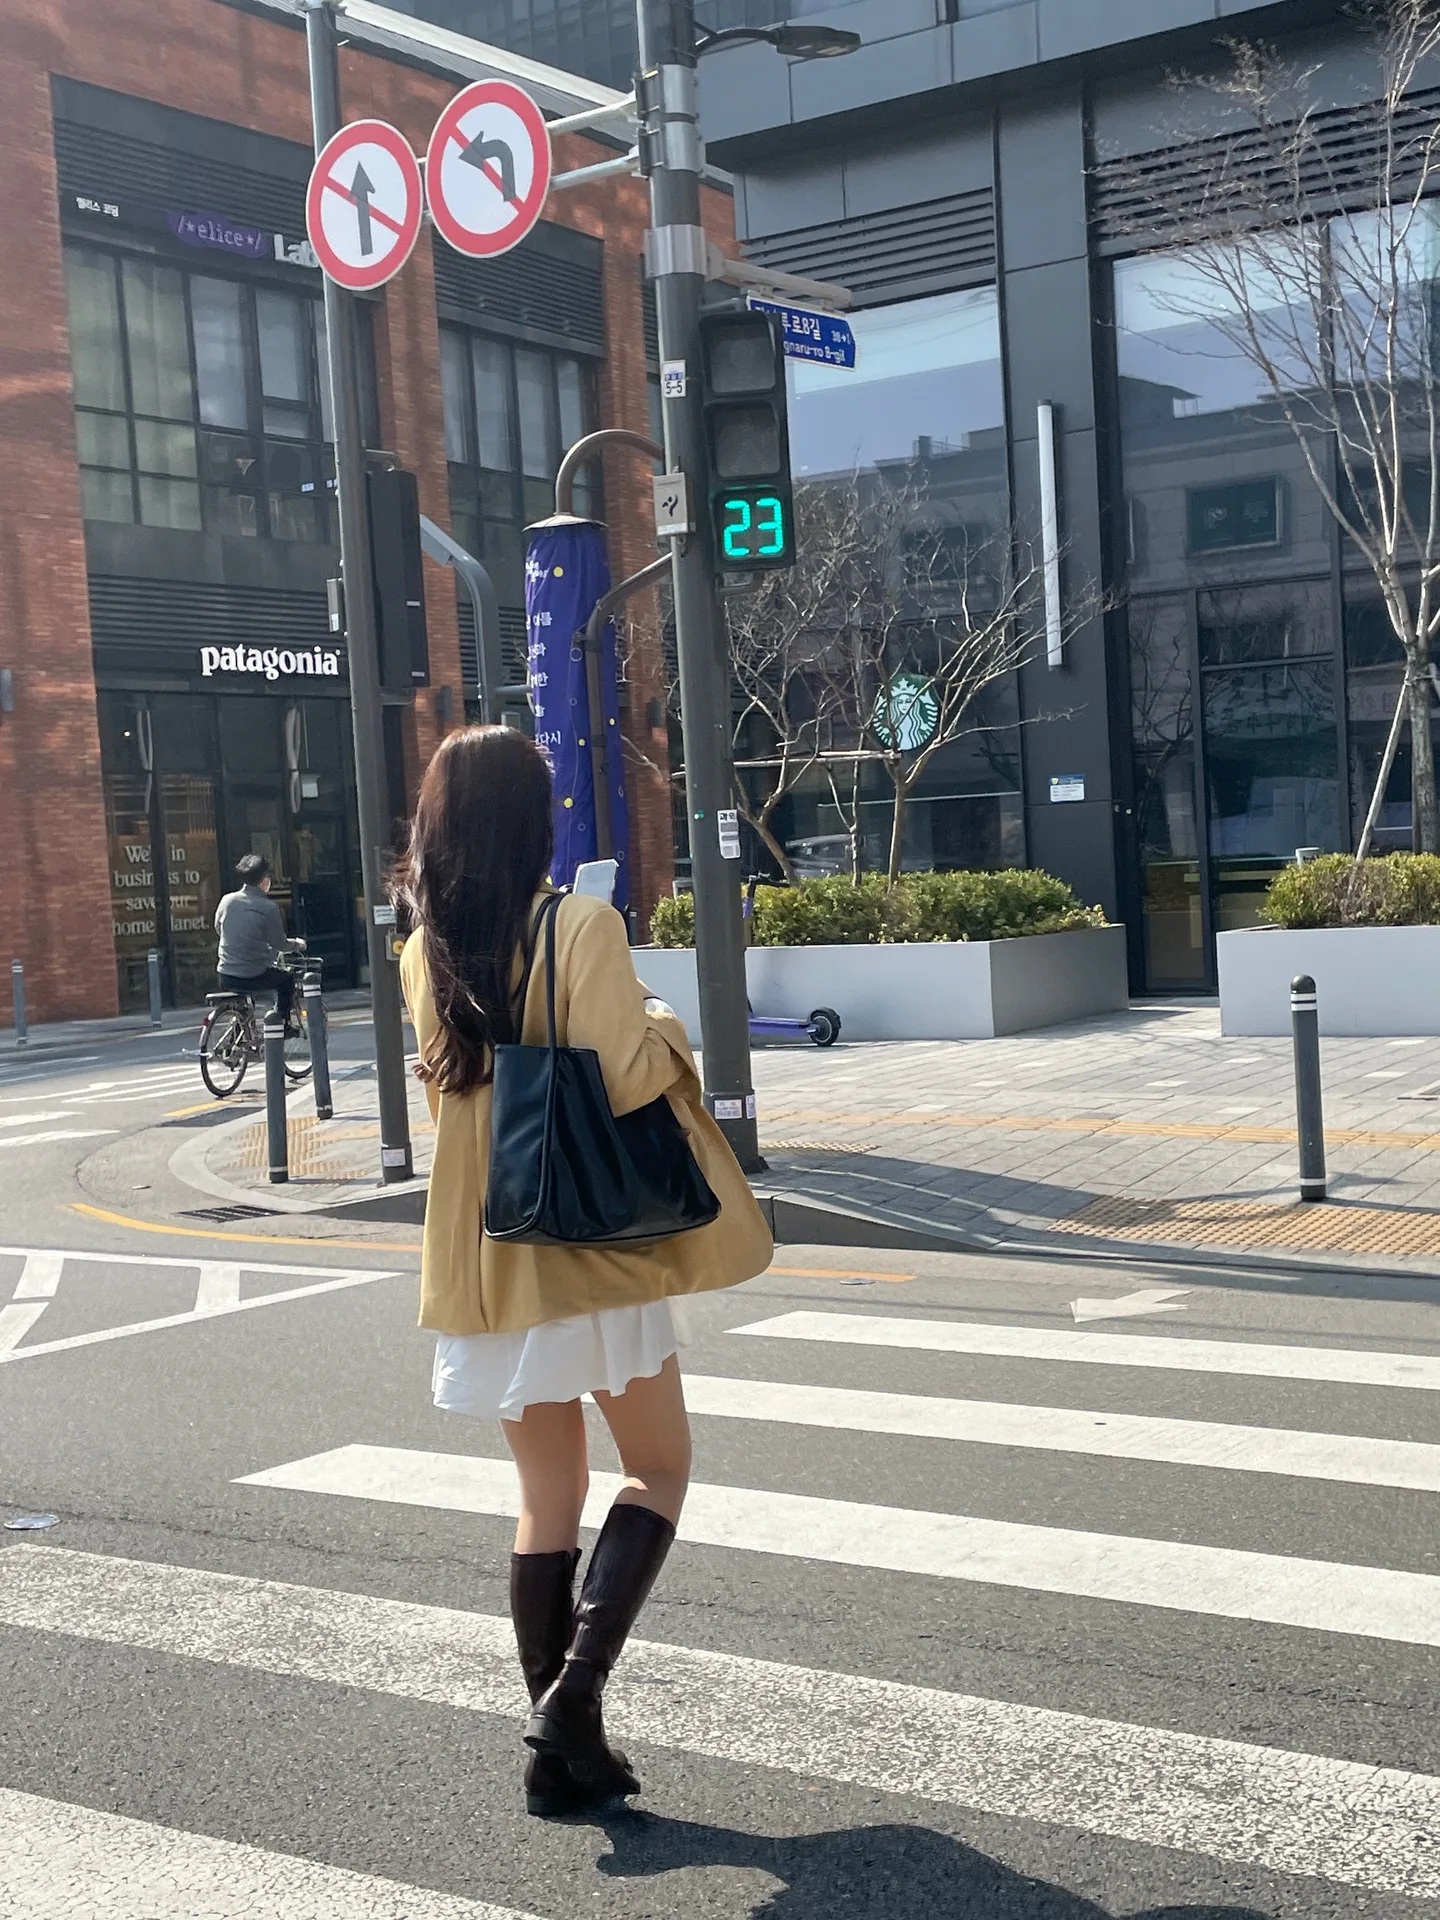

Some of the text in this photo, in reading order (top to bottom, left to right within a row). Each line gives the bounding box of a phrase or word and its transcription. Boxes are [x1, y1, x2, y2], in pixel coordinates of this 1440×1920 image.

[783, 340, 823, 358] gnaru-ro
[666, 381, 682, 394] 5-5
[723, 497, 783, 556] 23
[200, 644, 339, 680] patagonia
[185, 868, 200, 884] to
[170, 915, 210, 932] lanet.
